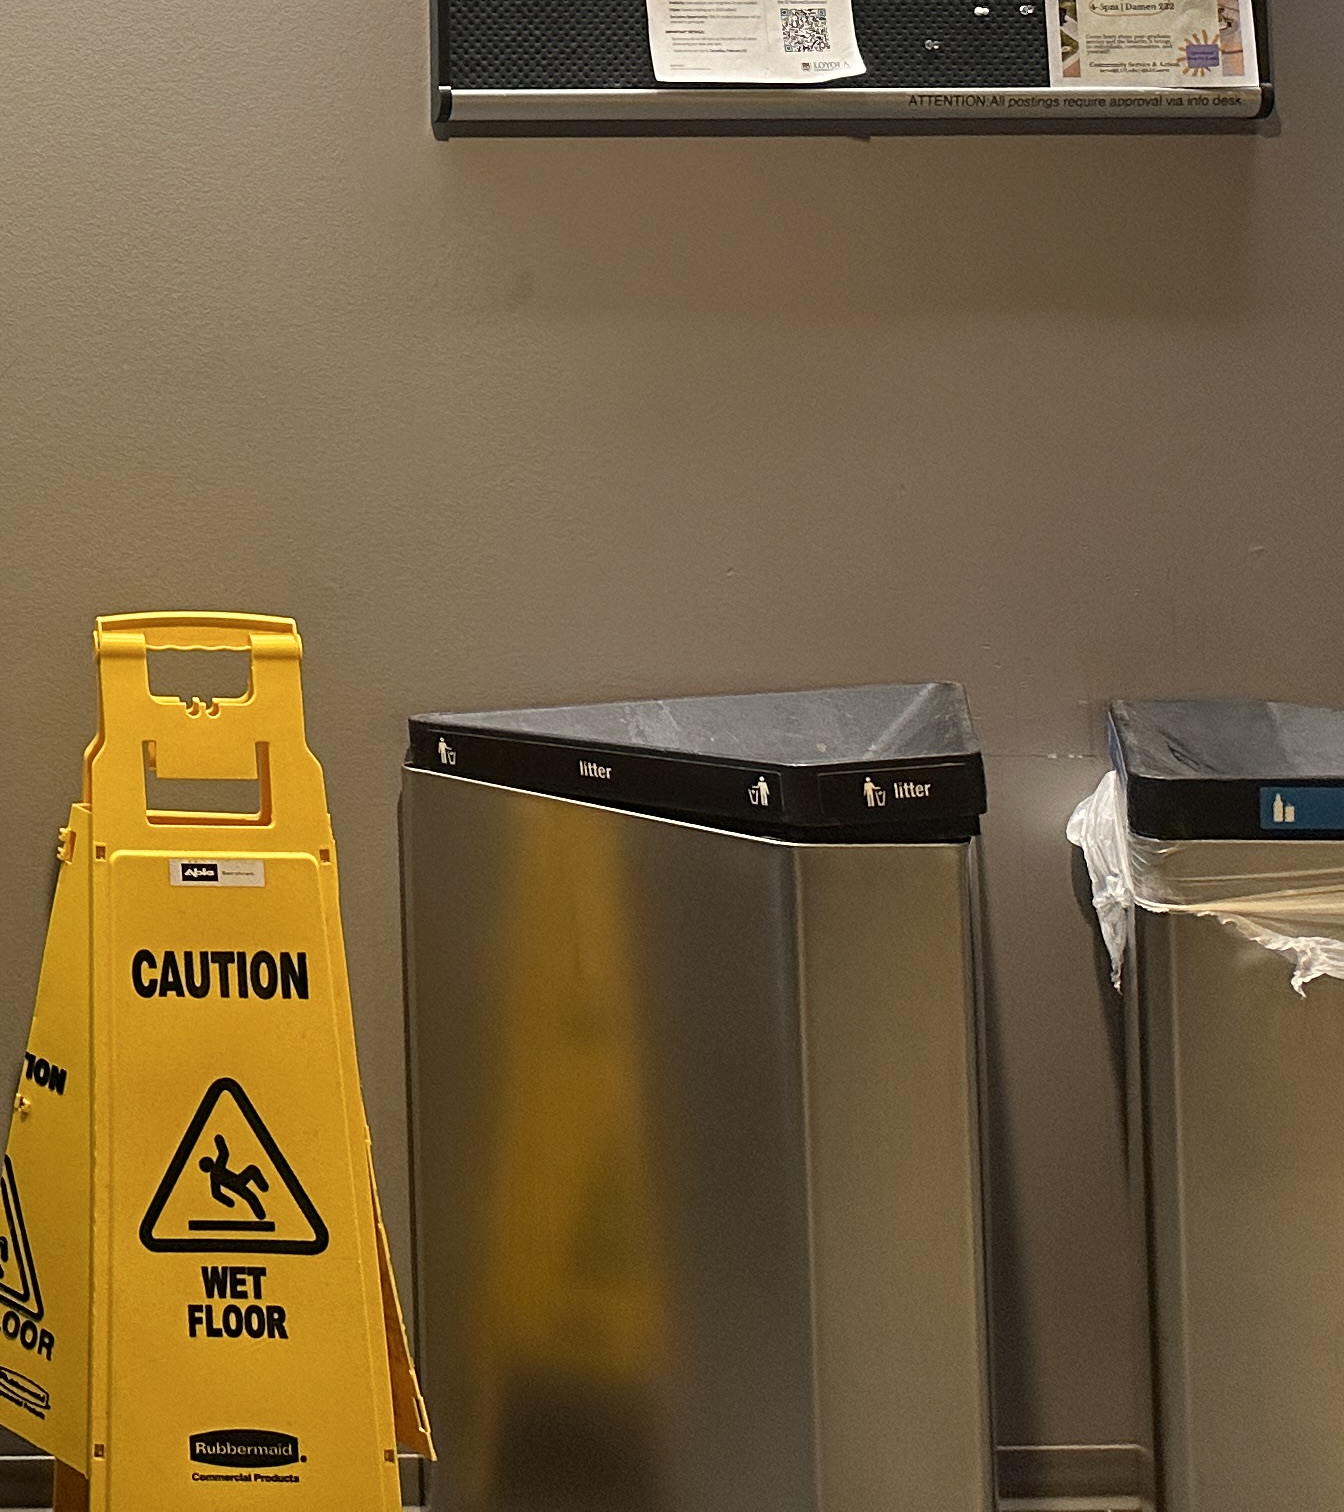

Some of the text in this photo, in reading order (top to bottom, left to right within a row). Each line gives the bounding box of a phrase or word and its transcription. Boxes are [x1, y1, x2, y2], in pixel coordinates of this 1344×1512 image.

[1008, 95, 1062, 108] postings
[1064, 95, 1106, 110] require
[1110, 95, 1162, 109] approval
[1165, 95, 1184, 107] via
[1187, 94, 1209, 107] info
[578, 760, 613, 780] litter
[892, 780, 931, 800] litter
[132, 949, 309, 1000] CAUTION
[24, 1052, 67, 1096] TION
[201, 1266, 267, 1300] WET
[188, 1304, 289, 1339] FLOOR
[195, 1441, 293, 1457] Rubbermaid
[191, 1472, 300, 1484] Commercial Products
